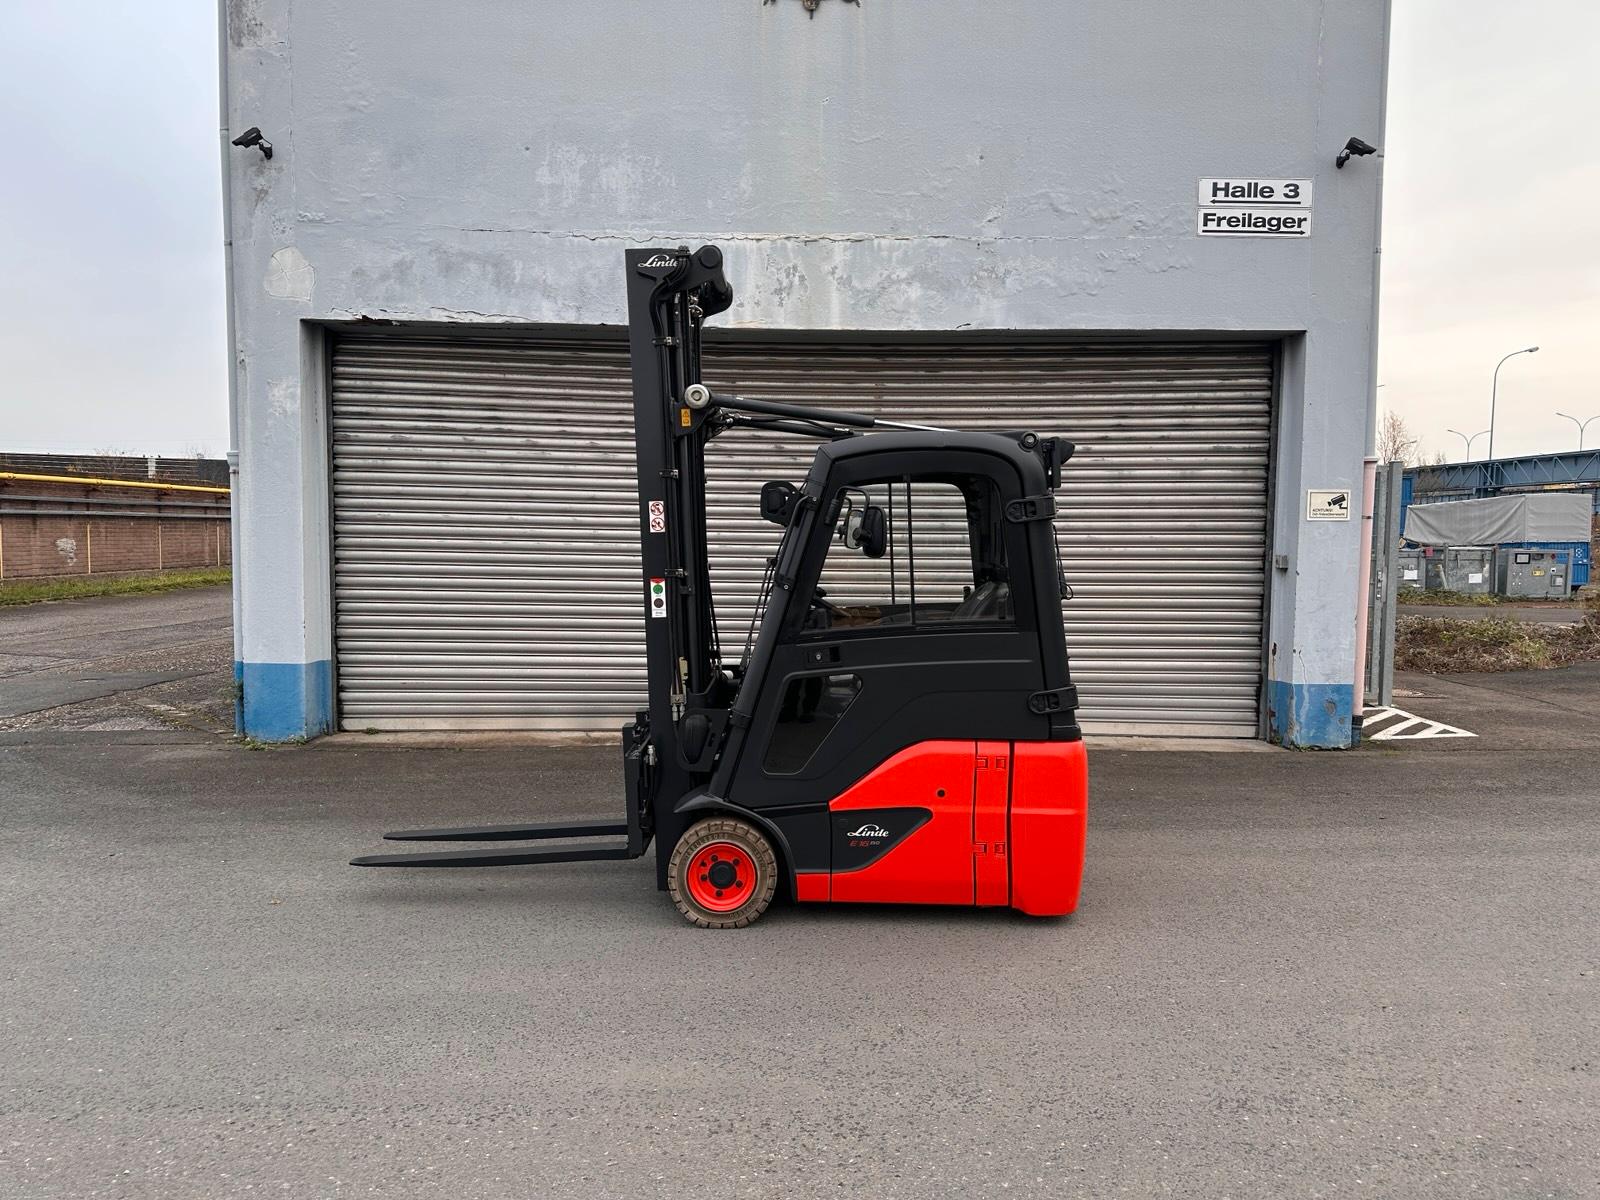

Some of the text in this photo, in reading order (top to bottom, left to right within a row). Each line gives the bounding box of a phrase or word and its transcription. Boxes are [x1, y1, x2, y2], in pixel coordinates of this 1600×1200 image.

[1212, 182, 1300, 199] Halle 3
[1202, 213, 1308, 232] Freilager
[847, 823, 889, 837] Linde
